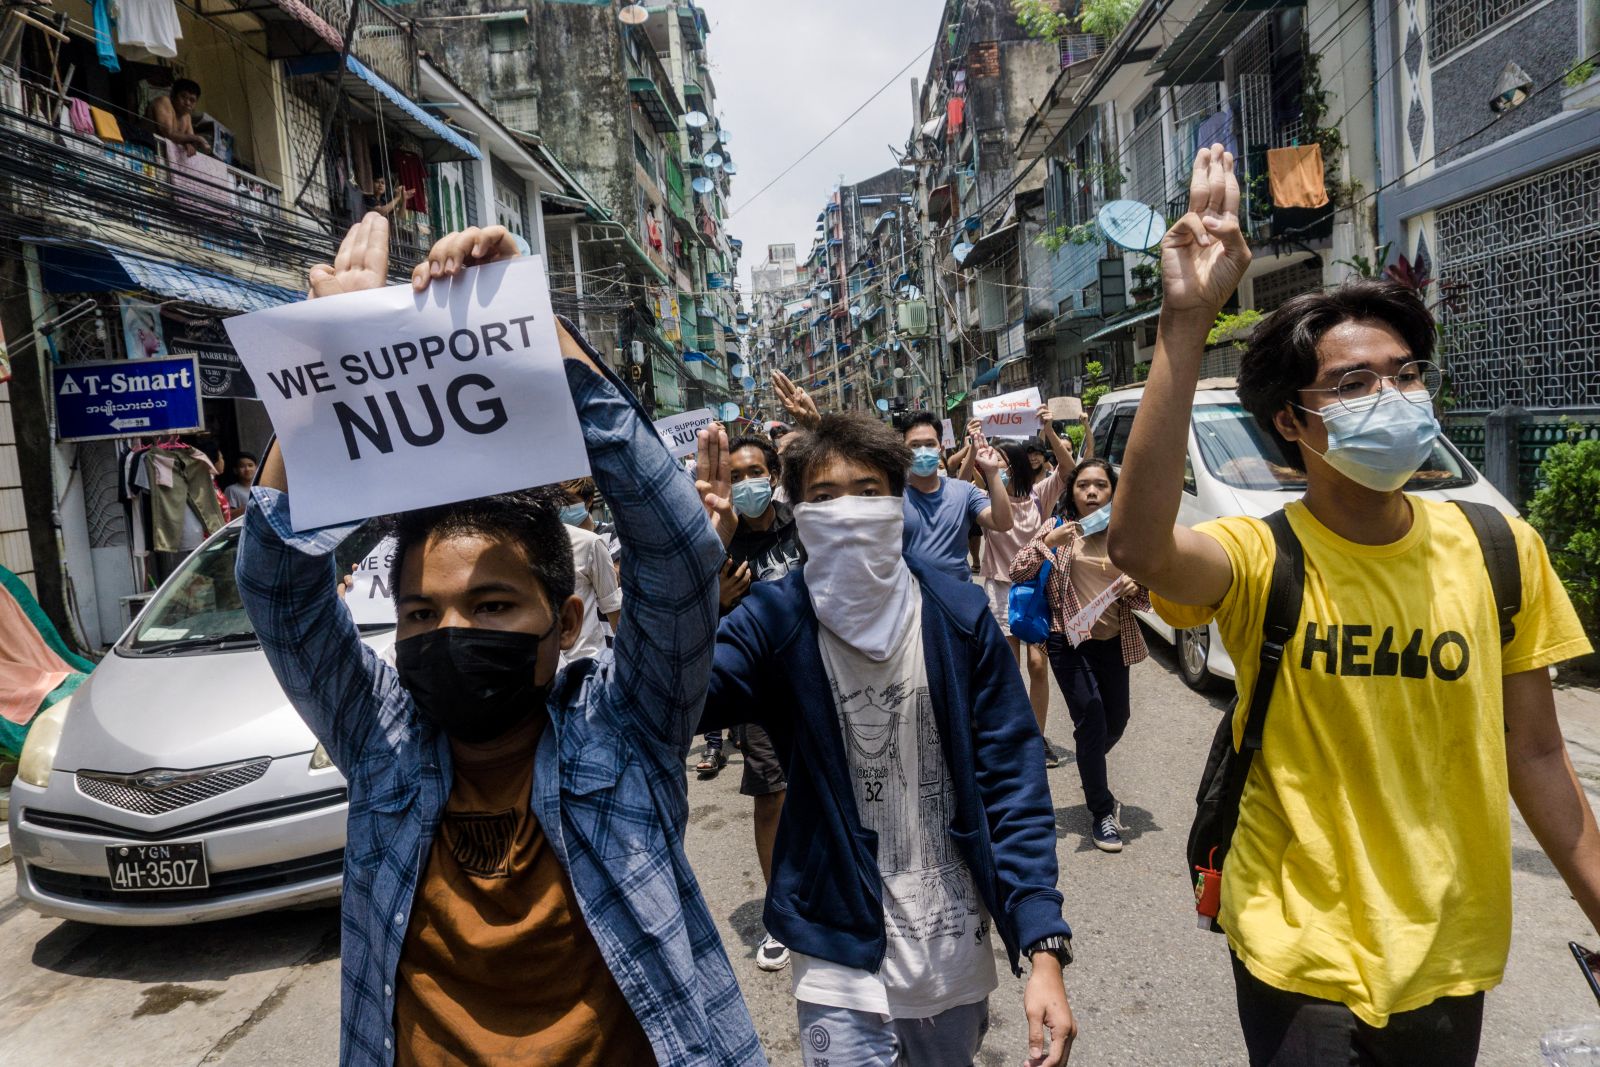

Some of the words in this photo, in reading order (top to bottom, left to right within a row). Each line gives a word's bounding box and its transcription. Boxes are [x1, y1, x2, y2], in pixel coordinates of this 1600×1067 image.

[267, 361, 336, 400] WE
[339, 315, 535, 386] SUPPORT
[83, 367, 192, 396] T-Smart
[333, 373, 509, 460] NUG
[660, 427, 674, 437] WE
[674, 417, 710, 432] SUPPORT
[987, 412, 1022, 425] NUG
[1300, 621, 1470, 681] HELLO
[865, 781, 883, 802] 32
[138, 846, 170, 859] YGN
[115, 859, 198, 887] 4H-3507
